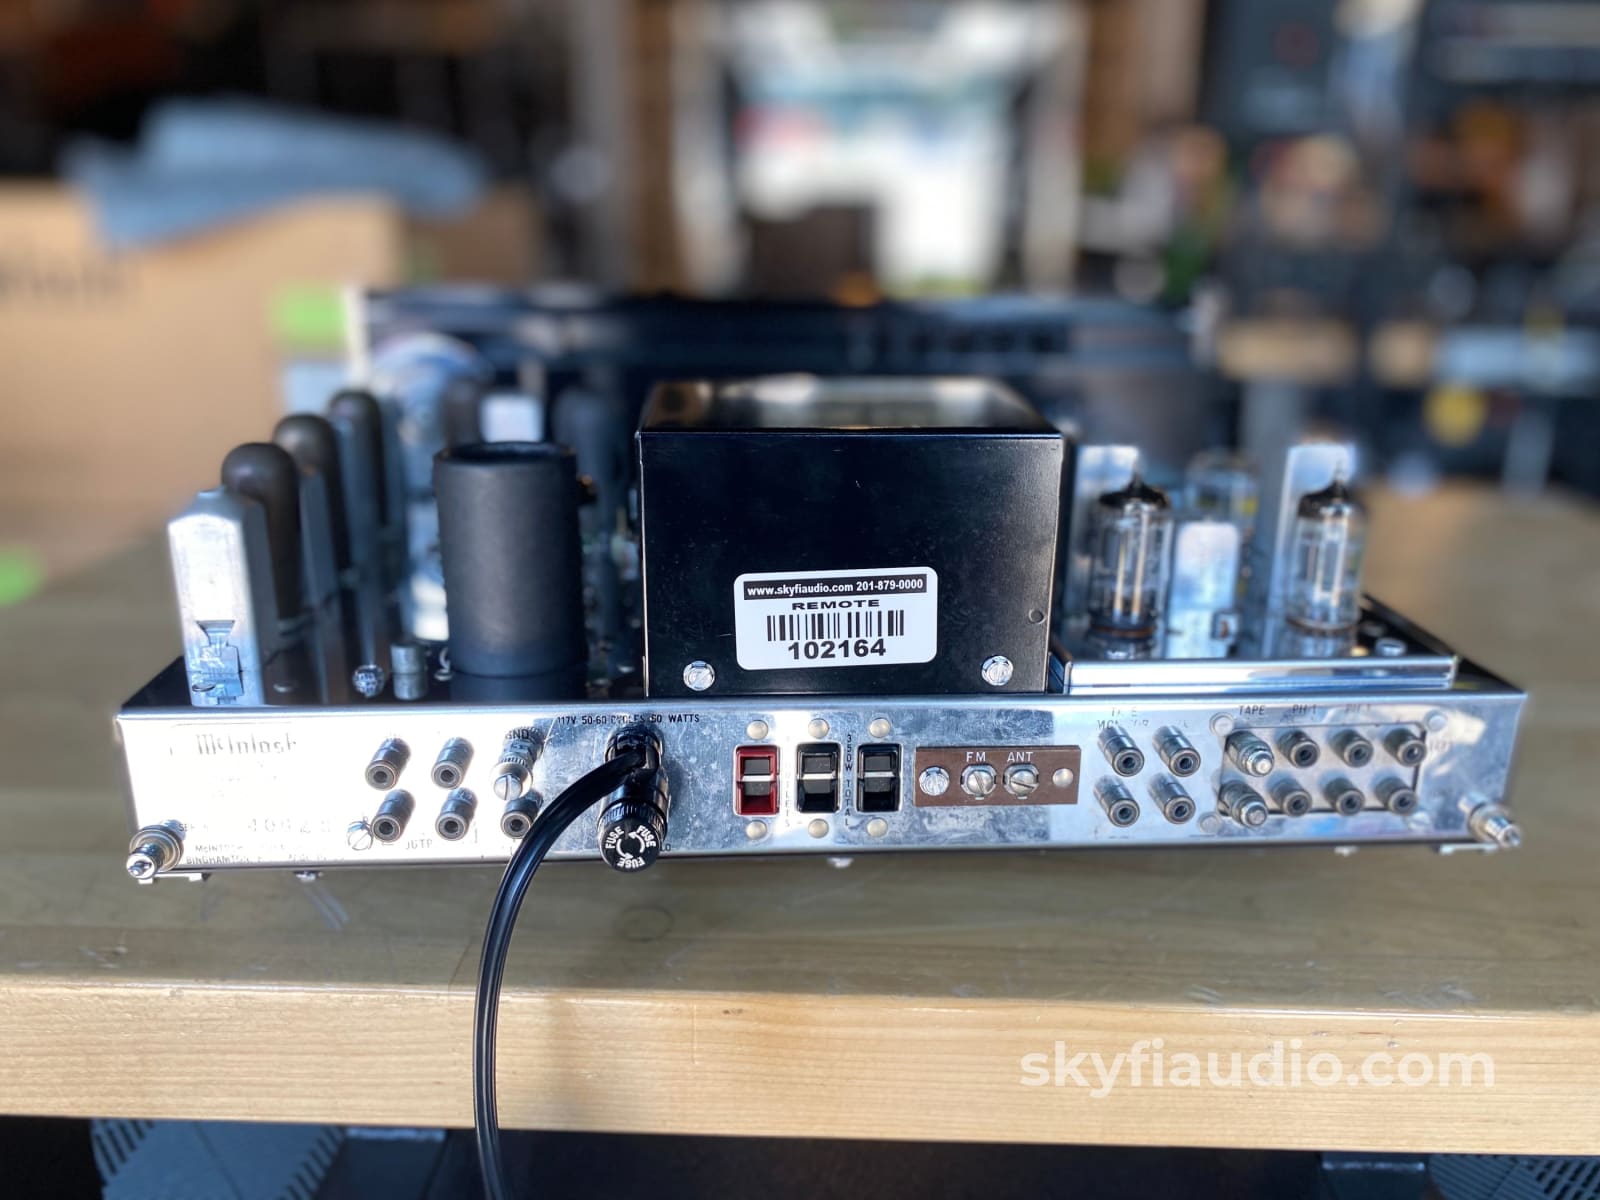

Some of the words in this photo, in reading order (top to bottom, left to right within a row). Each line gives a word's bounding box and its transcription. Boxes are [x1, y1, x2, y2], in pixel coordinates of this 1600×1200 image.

[747, 582, 854, 598] www.skyfiaudio.com
[855, 578, 924, 592] 201-879-0000
[791, 599, 880, 611] REMOTE
[788, 638, 886, 660] 102164
[1239, 704, 1265, 716] TAPE
[668, 713, 700, 723] WATTS
[966, 751, 986, 763] FM
[1006, 751, 1034, 763] ANT
[605, 826, 625, 849] FUSE
[636, 825, 657, 848] FUSE
[616, 856, 646, 869] FUSE
